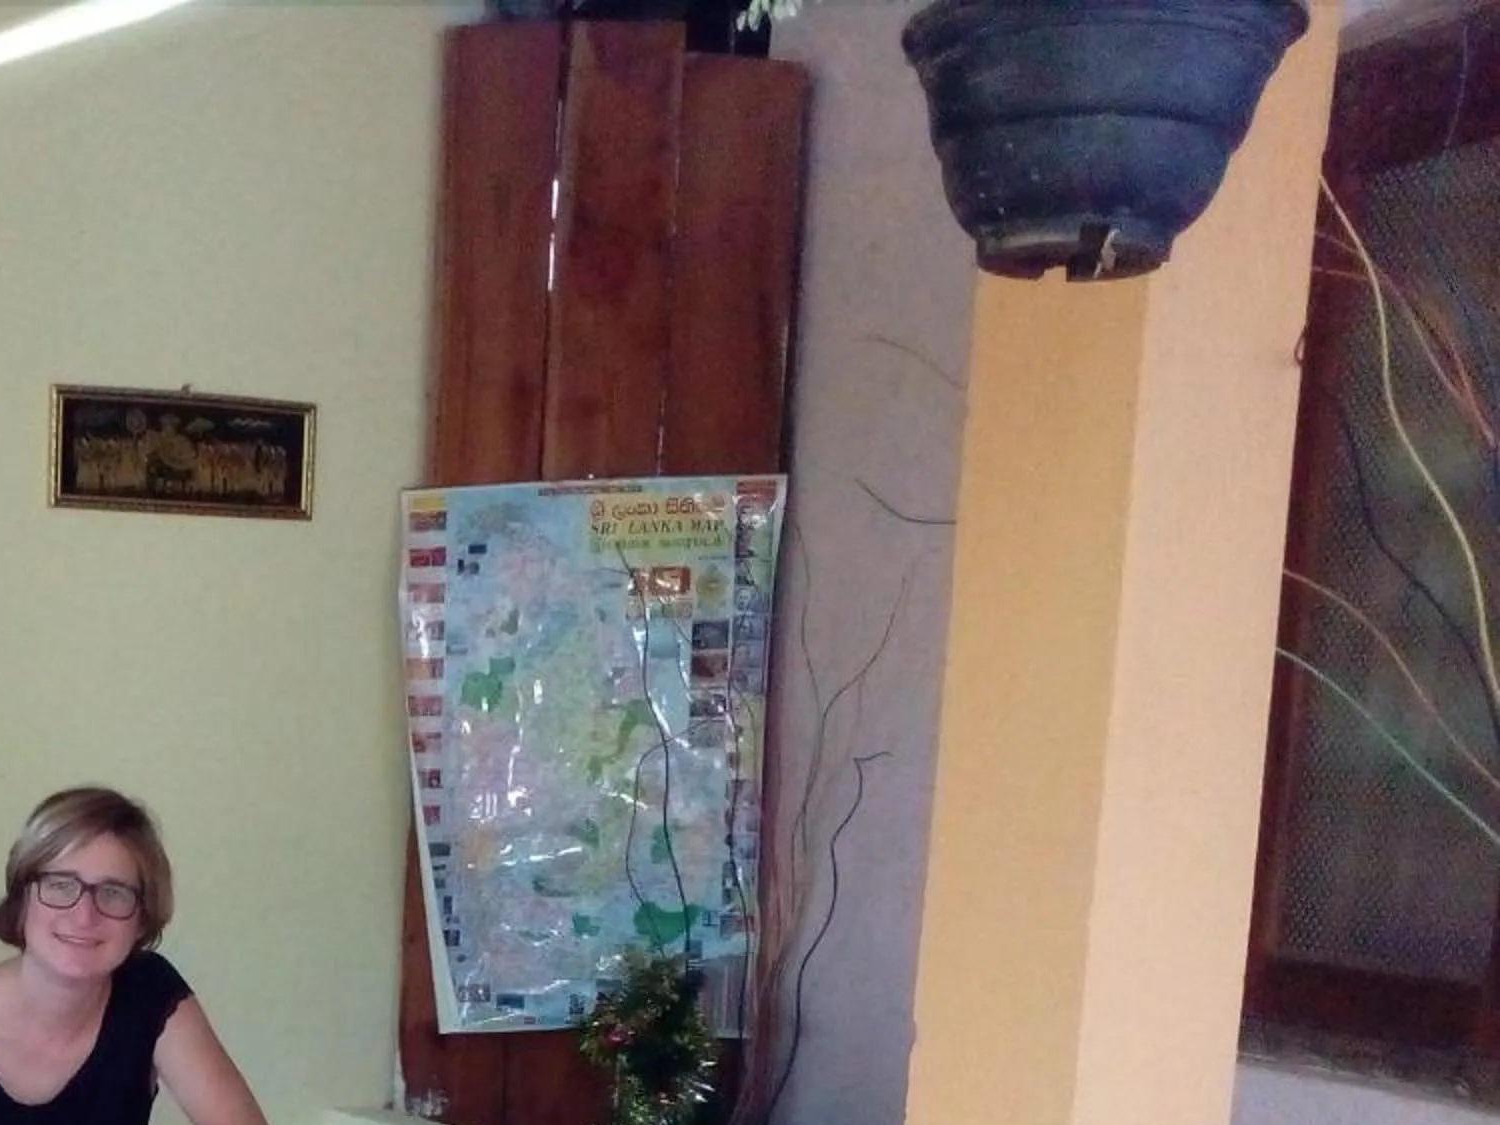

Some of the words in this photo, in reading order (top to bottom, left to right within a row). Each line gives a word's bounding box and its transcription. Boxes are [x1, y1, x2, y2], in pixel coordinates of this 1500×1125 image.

[591, 521, 619, 535] SRI
[628, 519, 683, 534] LANKA
[691, 518, 725, 532] MAP
